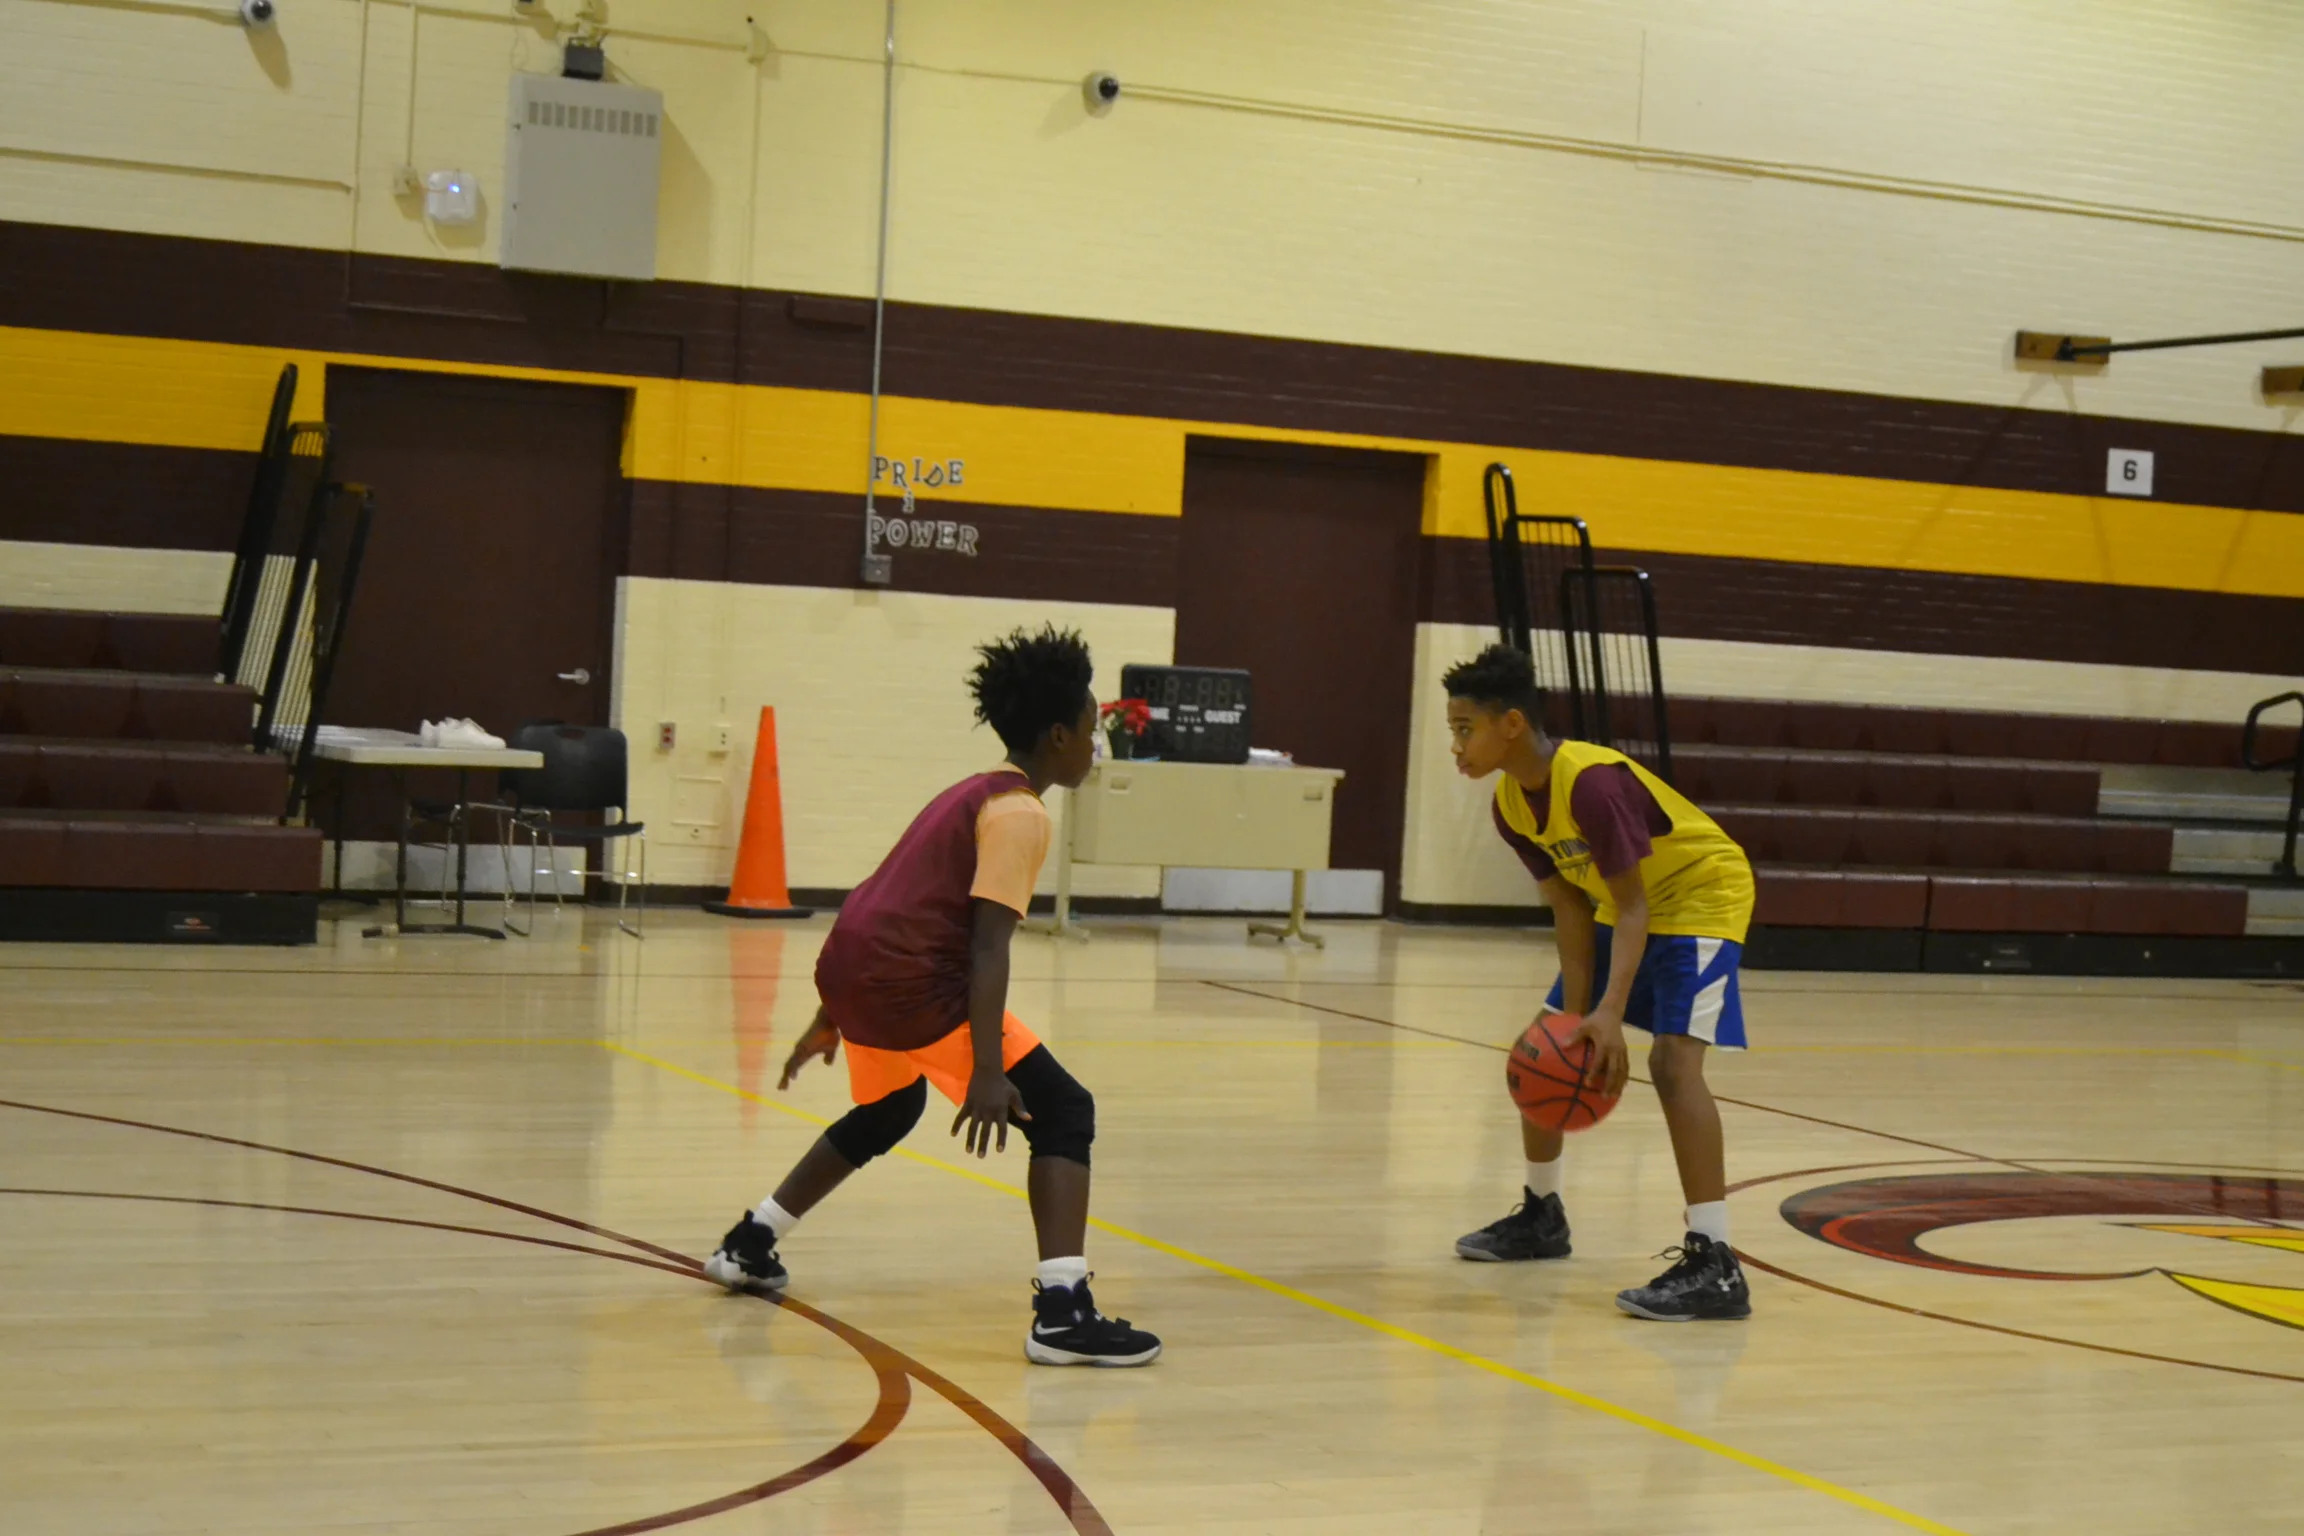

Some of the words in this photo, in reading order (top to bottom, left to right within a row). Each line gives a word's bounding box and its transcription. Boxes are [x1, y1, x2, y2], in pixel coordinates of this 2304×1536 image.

[871, 455, 964, 488] PRIDE
[2123, 459, 2138, 481] 6
[869, 515, 980, 557] POWER
[1204, 709, 1242, 725] GUEST
